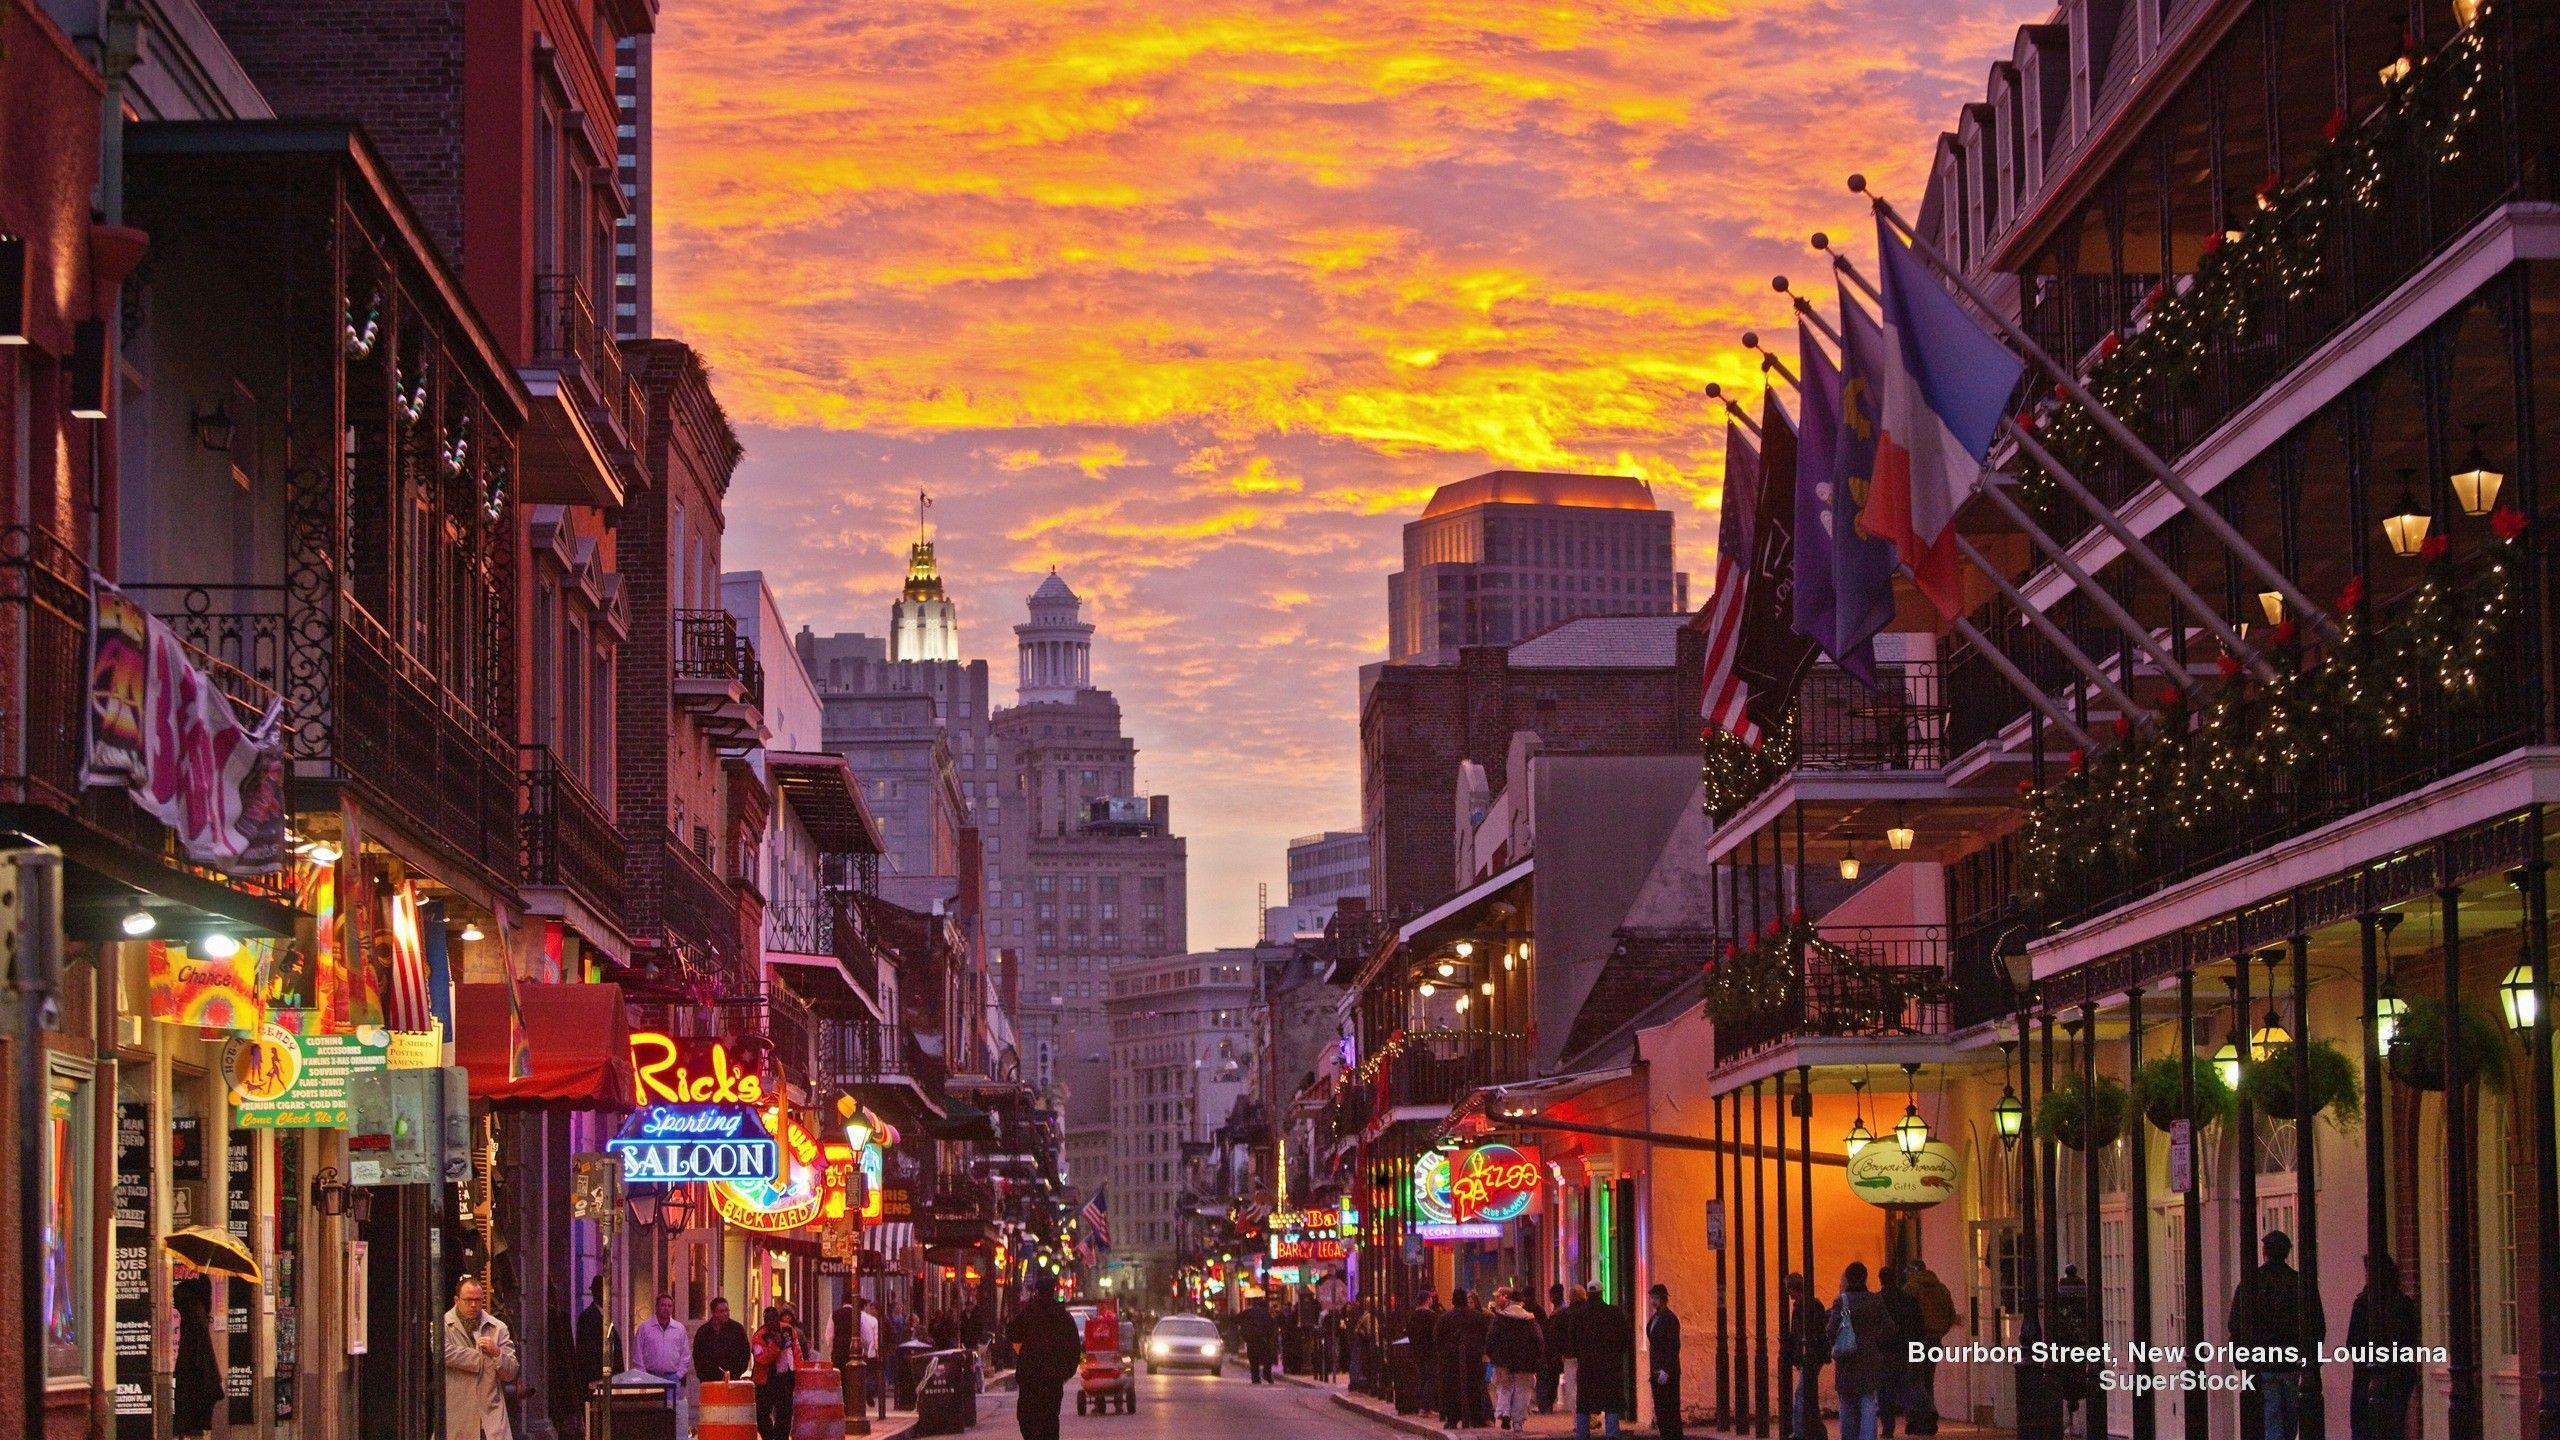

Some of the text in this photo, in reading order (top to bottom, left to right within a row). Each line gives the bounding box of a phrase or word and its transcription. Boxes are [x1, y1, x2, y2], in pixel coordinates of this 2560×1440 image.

[305, 1037, 343, 1046] CLOTHING
[317, 1046, 361, 1056] ACCESSORIES
[629, 1032, 762, 1106] Rick's
[291, 1090, 318, 1098] SPORTS
[240, 1101, 276, 1110] PREMIUM
[309, 1100, 331, 1109] COLD
[241, 1112, 273, 1126] Come
[275, 1111, 311, 1126] Check
[644, 1107, 742, 1137] Sporting
[119, 1134, 146, 1147] EGEND
[621, 1143, 765, 1178] SALOON
[723, 1200, 809, 1228] BACK YARD
[115, 1247, 147, 1258] ESUS
[115, 1259, 147, 1270] OVES
[116, 1270, 142, 1280] OU!
[116, 1383, 143, 1394] EMA
